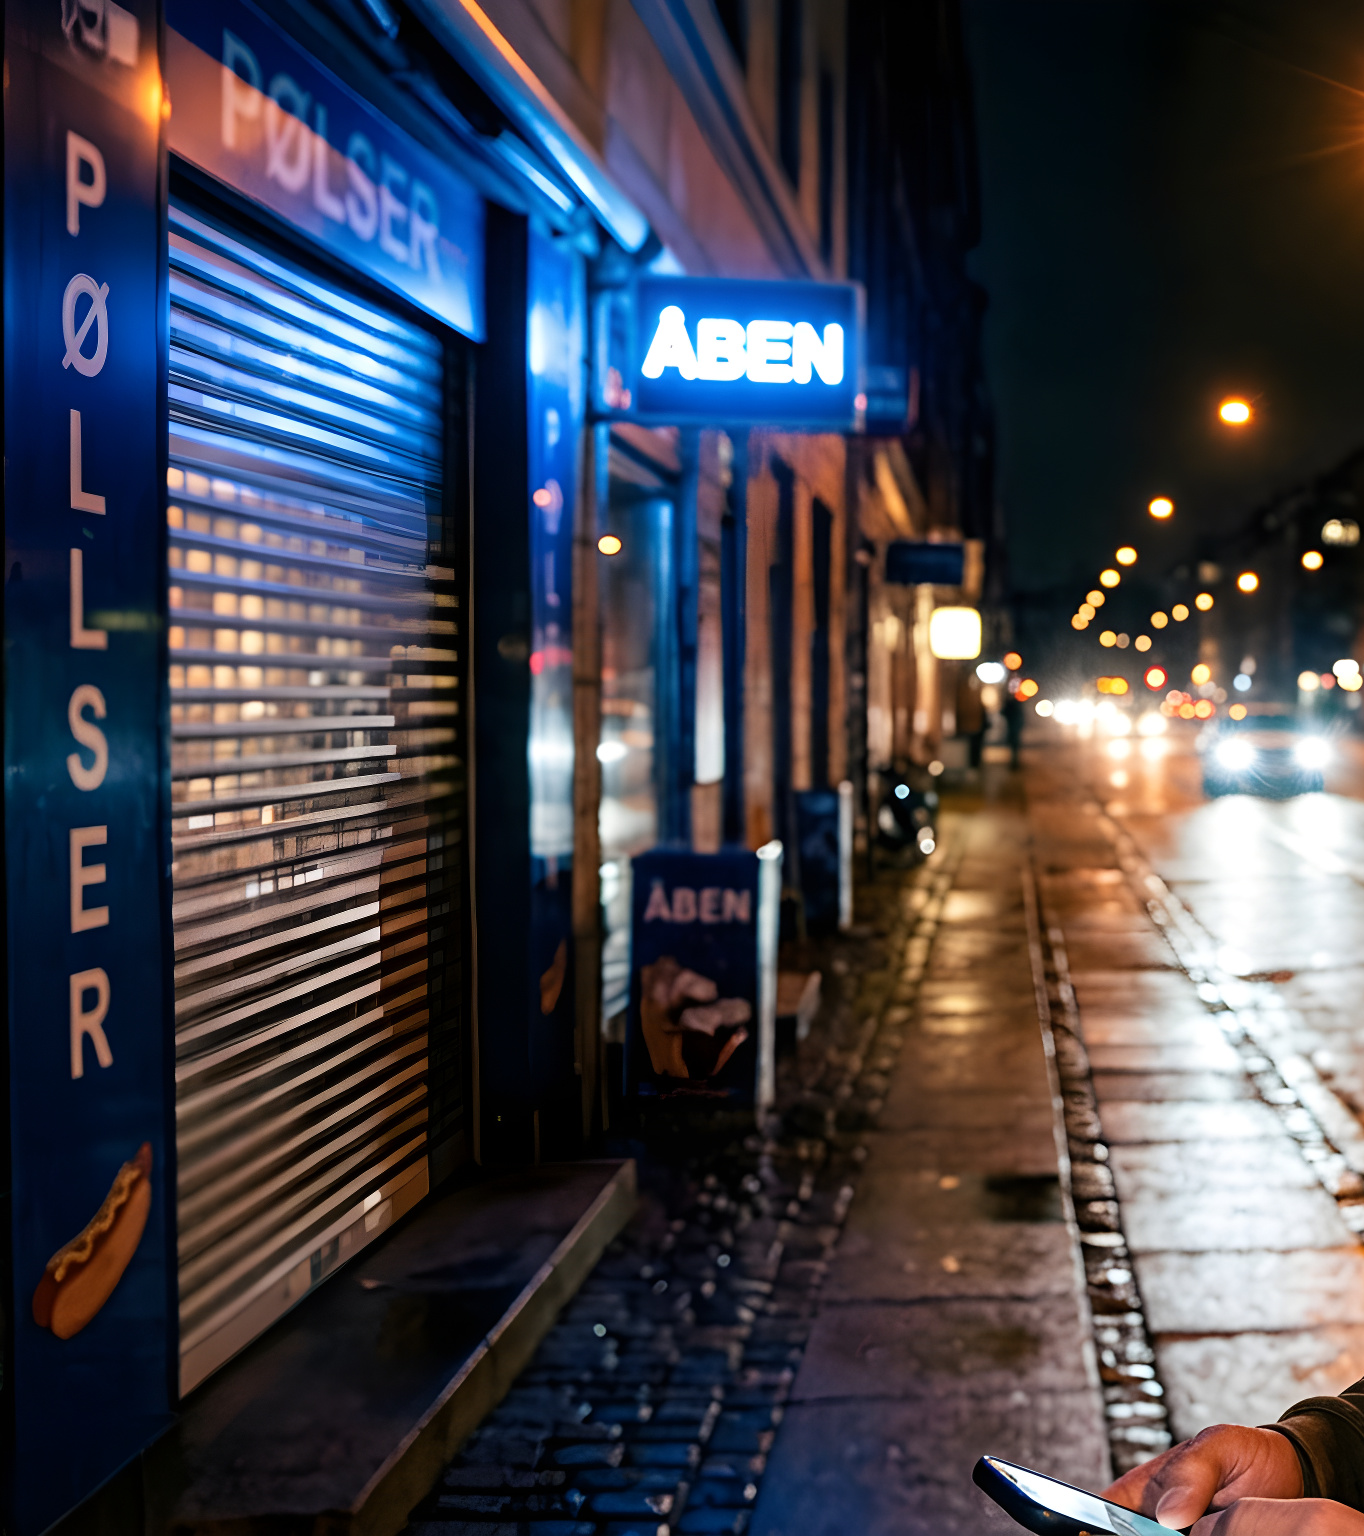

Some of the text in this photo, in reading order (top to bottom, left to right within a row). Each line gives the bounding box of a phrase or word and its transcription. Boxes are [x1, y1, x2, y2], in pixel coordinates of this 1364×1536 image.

[220, 27, 443, 288] PØLSER
[641, 305, 844, 385] ÅBEN
[62, 128, 113, 1080] PØLLSER
[644, 877, 751, 924] ÅBEN
